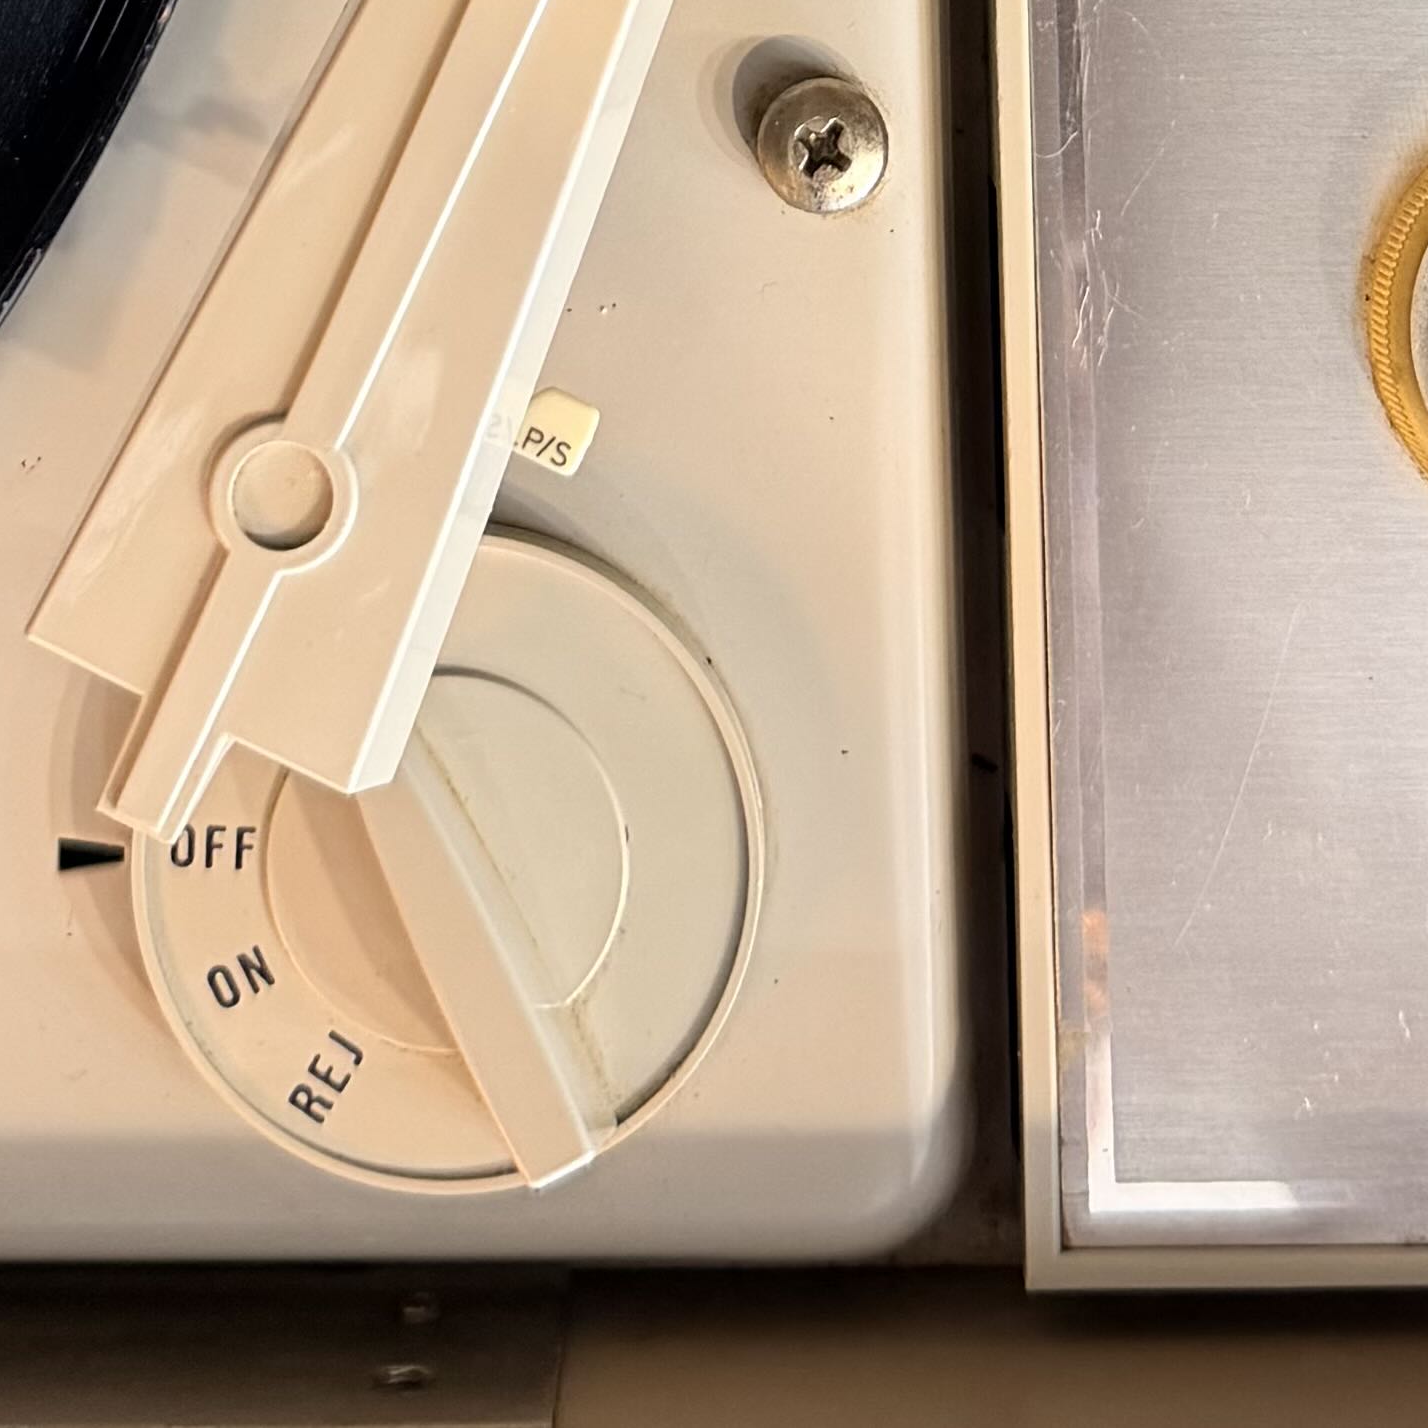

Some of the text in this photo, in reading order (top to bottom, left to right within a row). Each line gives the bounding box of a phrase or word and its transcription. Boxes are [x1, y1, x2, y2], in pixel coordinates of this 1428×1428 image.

[170, 824, 257, 870] OFF
[207, 945, 275, 1008] ON
[288, 1029, 364, 1124] REJ
